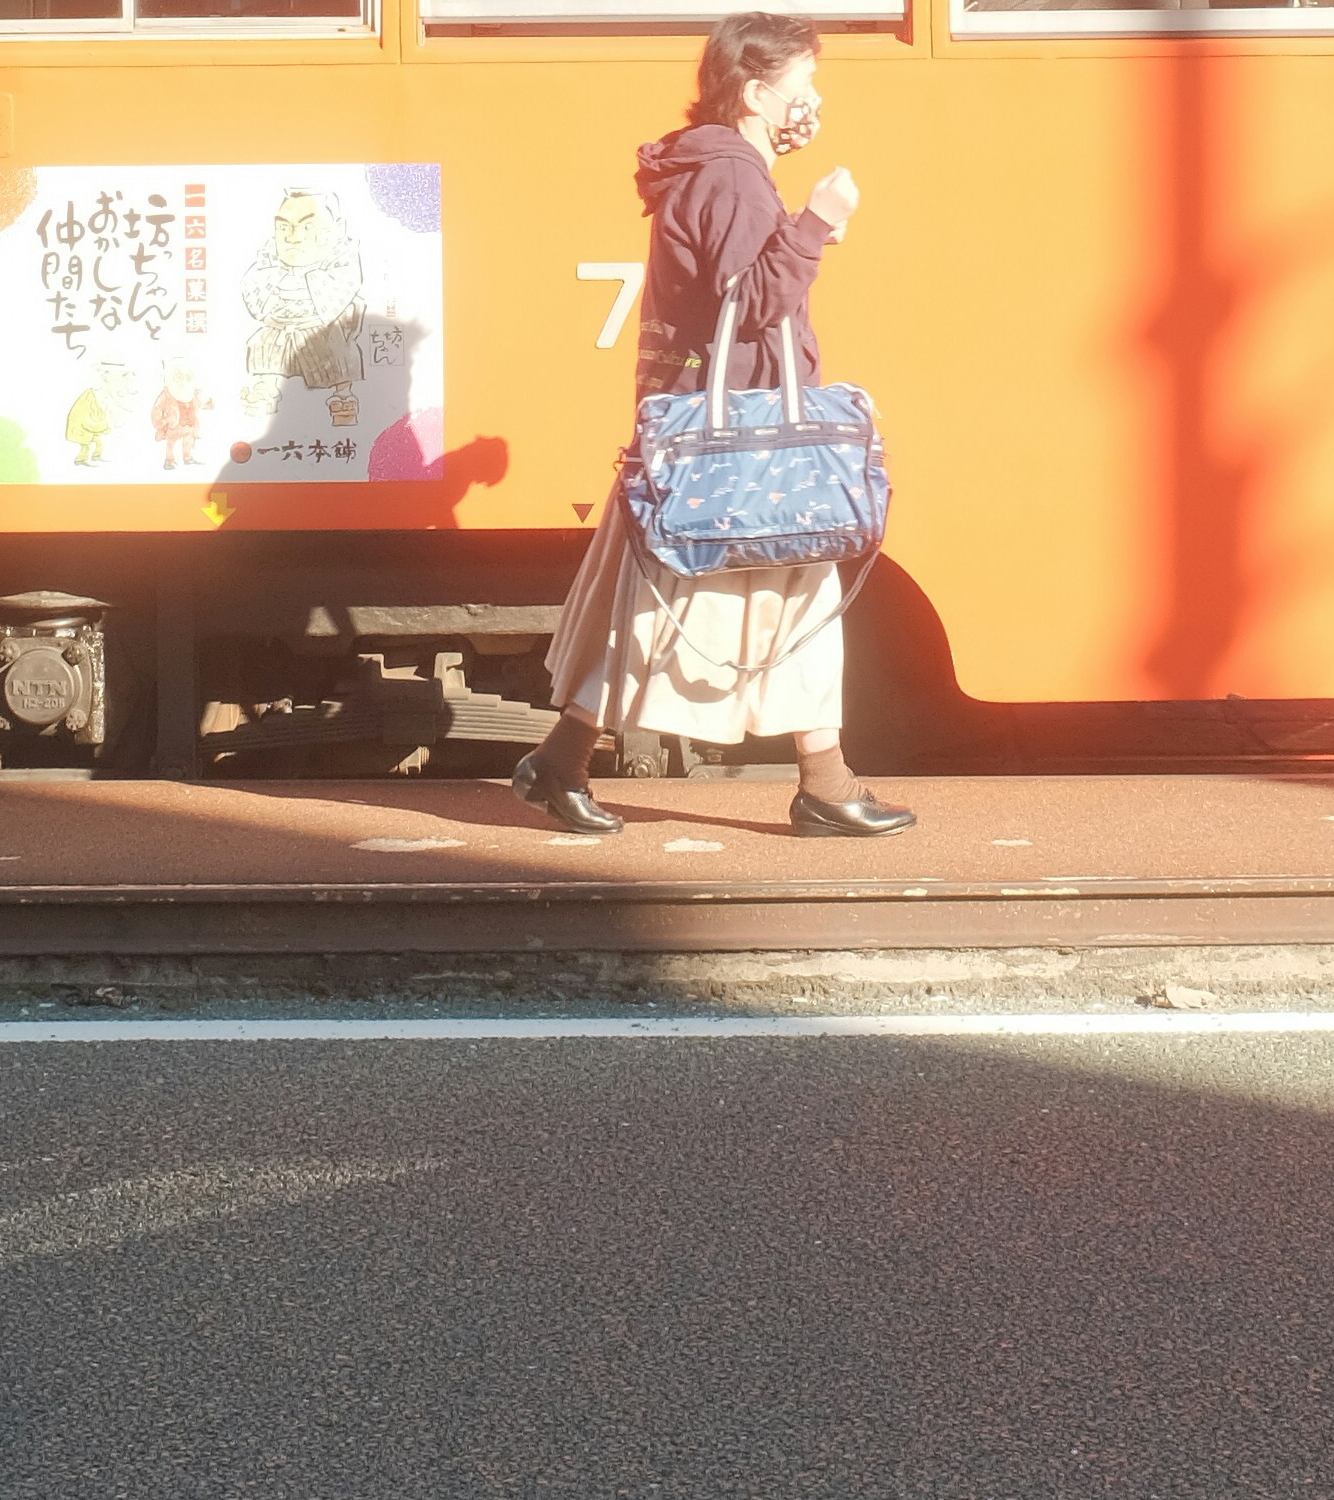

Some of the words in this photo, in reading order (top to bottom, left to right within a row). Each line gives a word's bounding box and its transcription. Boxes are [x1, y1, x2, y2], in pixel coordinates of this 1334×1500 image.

[36, 200, 91, 360] 仲間たち
[87, 190, 123, 331] おかしな
[123, 194, 178, 340] 坊っちゃんと
[12, 680, 67, 696] NTN
